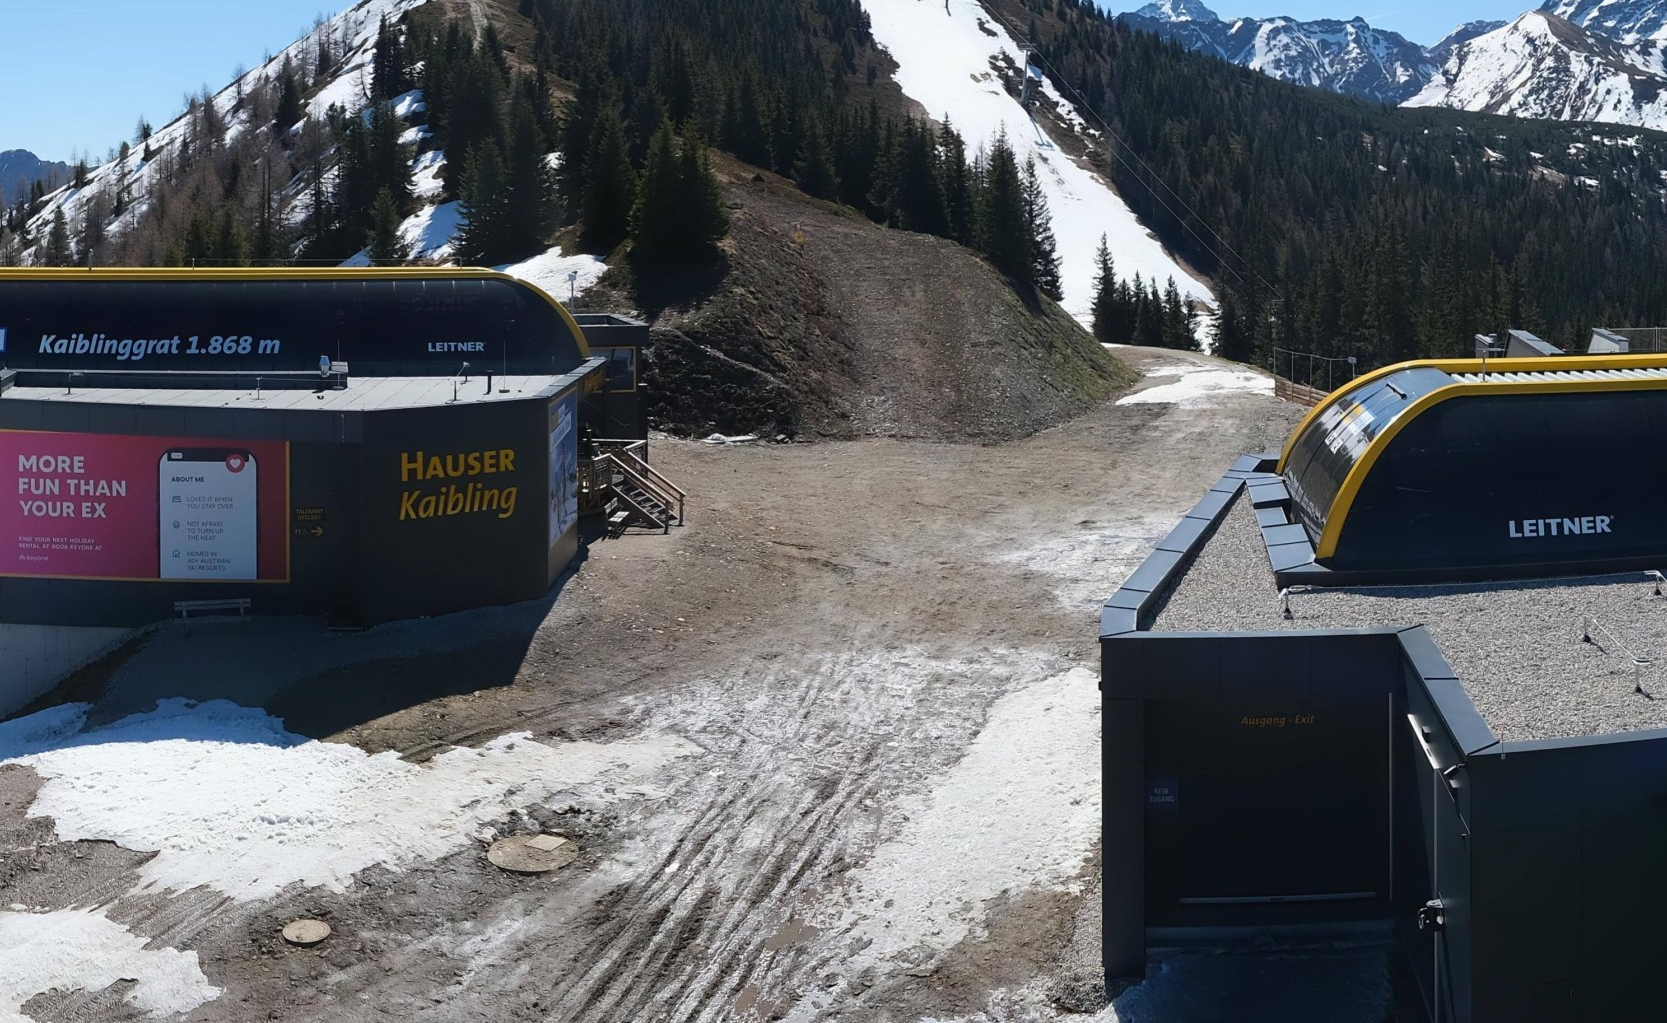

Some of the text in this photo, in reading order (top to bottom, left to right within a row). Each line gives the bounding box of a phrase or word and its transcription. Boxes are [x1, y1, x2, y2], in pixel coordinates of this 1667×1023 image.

[39, 333, 280, 360] Kaiblinggrat 1.868 m
[427, 342, 484, 352] LEITNER
[19, 455, 85, 473] MORE
[19, 477, 127, 496] FUN THAN
[20, 500, 107, 518] YOUR EX
[400, 483, 518, 520] Kaibling
[1241, 715, 1286, 727] Ausgang
[1295, 714, 1315, 724] Exit
